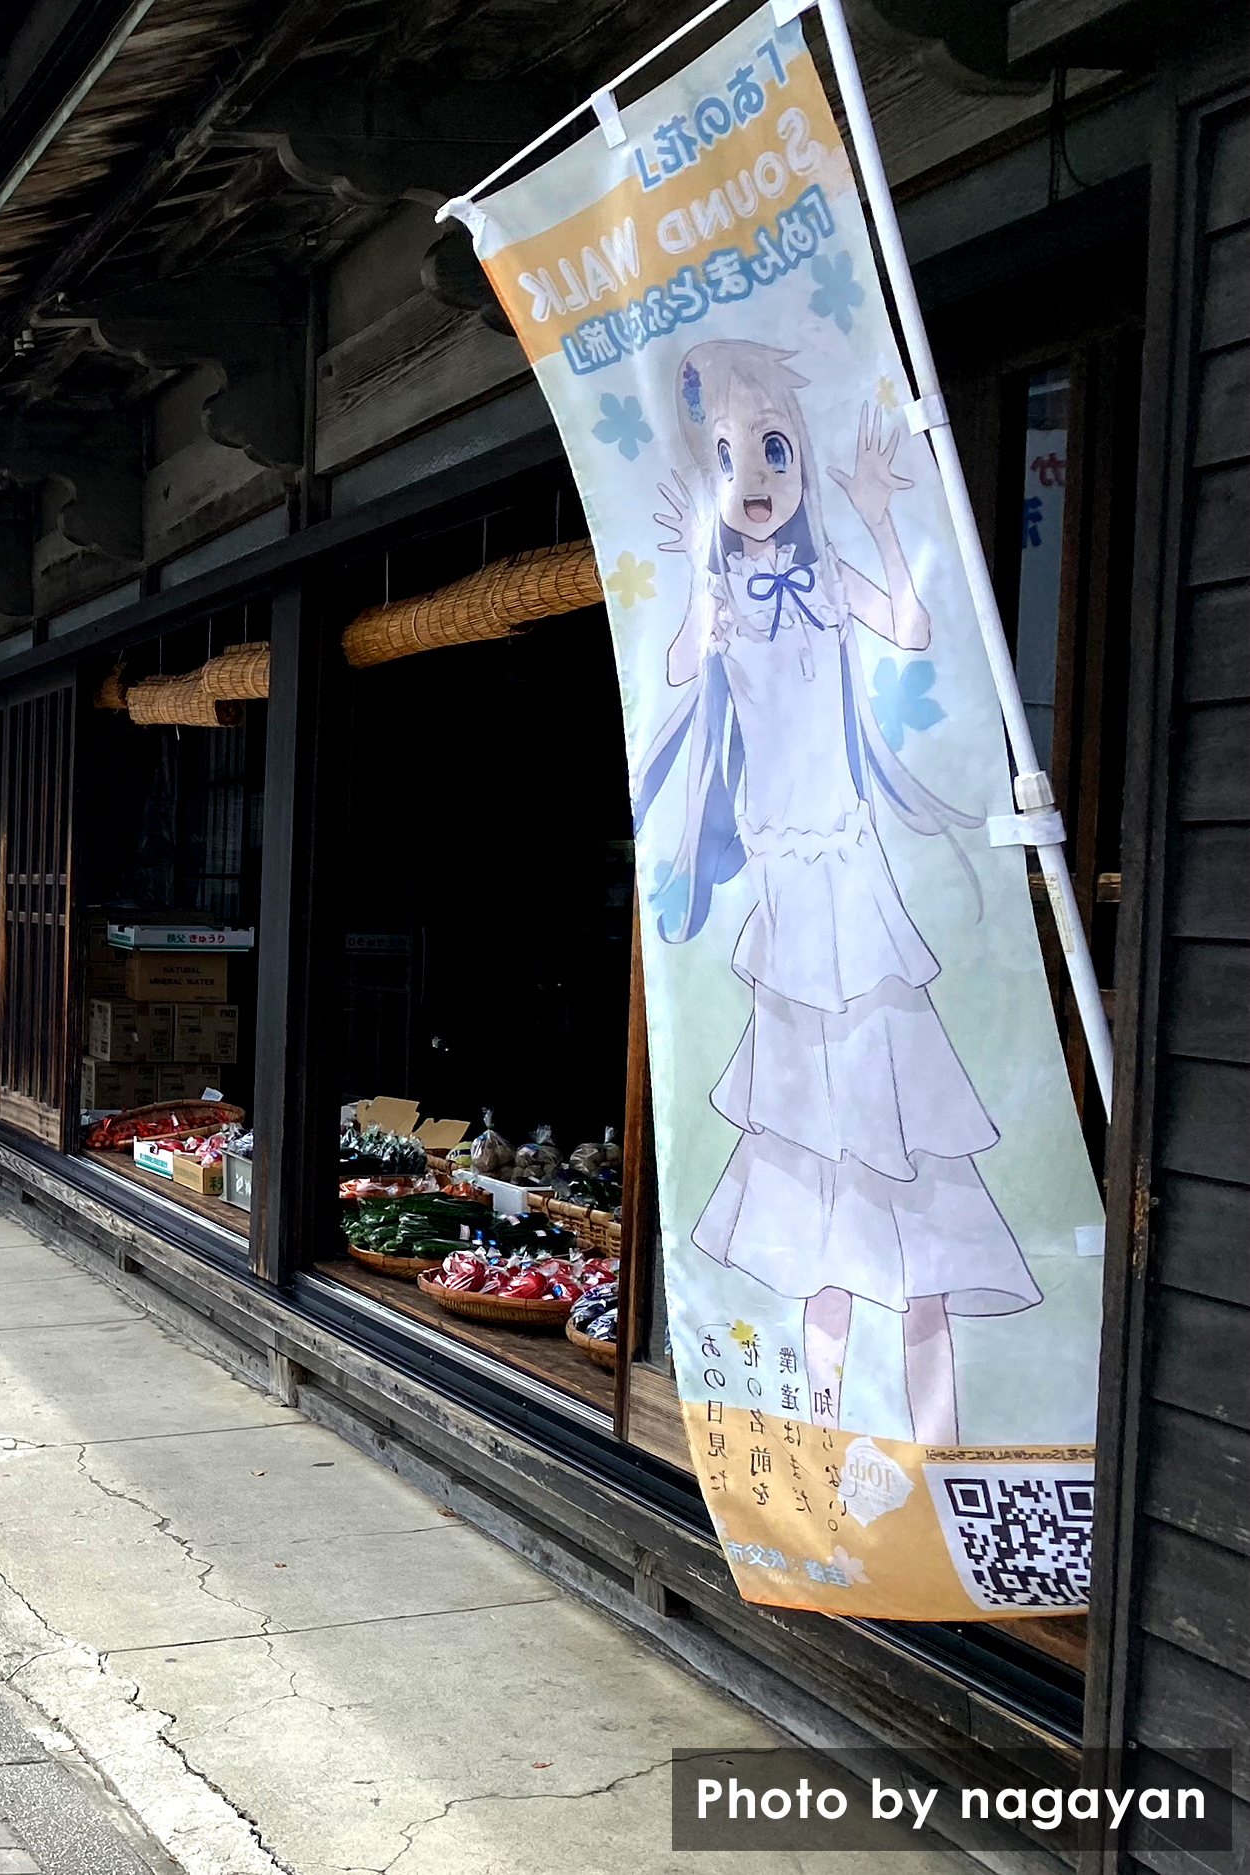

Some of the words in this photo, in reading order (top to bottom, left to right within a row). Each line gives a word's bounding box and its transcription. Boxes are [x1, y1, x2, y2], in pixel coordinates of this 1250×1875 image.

[188, 933, 226, 943] きゅうり
[163, 966, 202, 974] NATURAL
[149, 978, 183, 986] MINERAL
[186, 978, 215, 986] WATER
